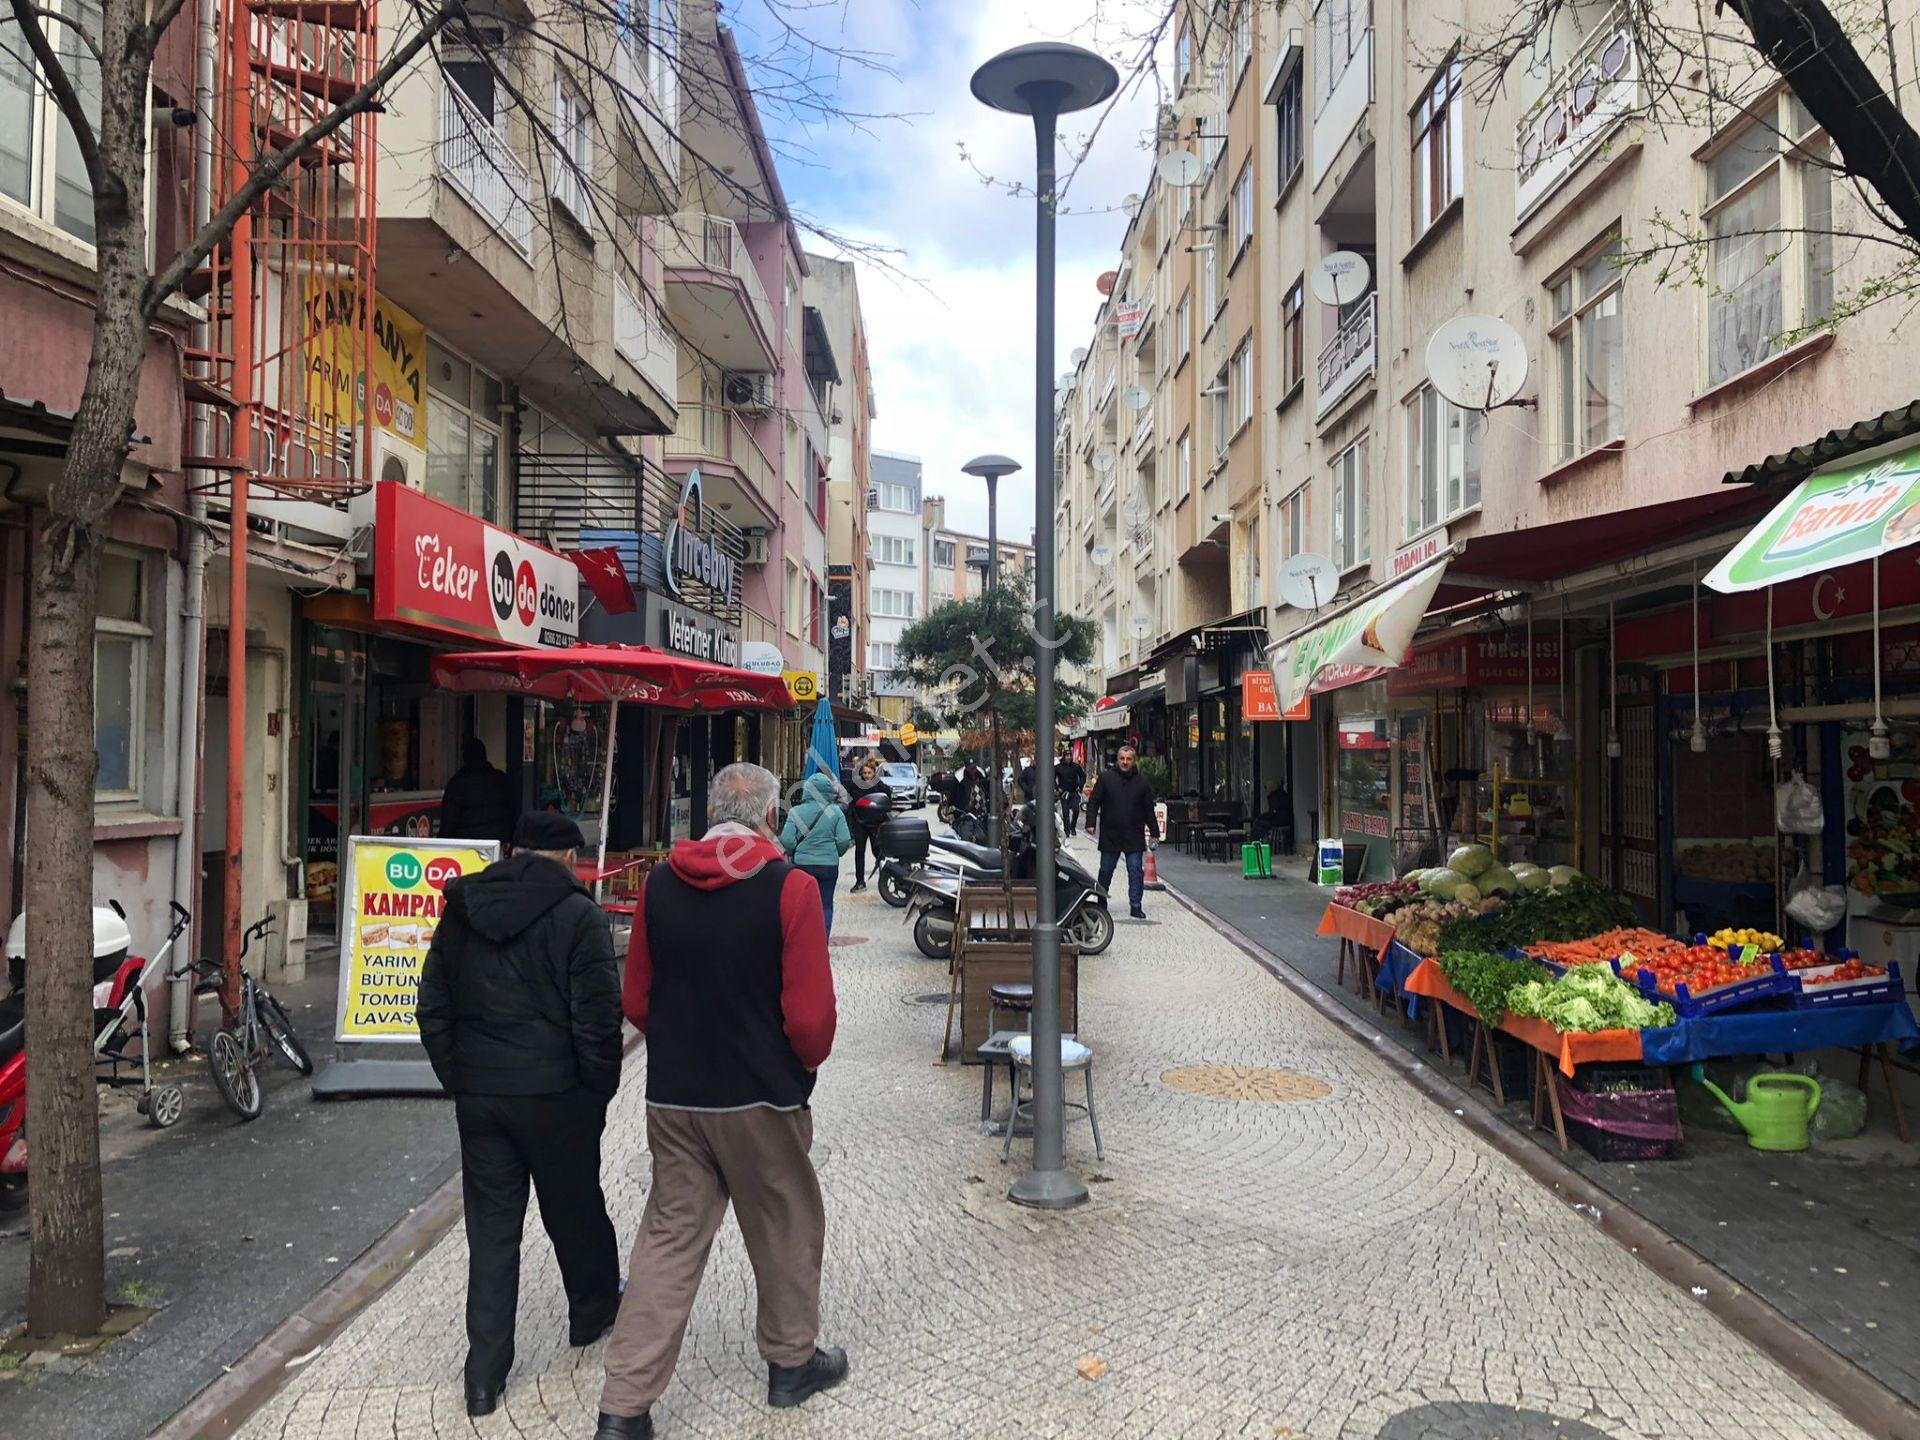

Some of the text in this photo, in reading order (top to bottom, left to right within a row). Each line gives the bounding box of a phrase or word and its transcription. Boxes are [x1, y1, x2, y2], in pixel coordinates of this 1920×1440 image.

[1777, 485, 1902, 545] Banvit
[540, 583, 576, 624] döner
[389, 863, 418, 879] BU
[362, 954, 417, 968] YARIM
[361, 971, 420, 987] BÜTÜN
[354, 1011, 415, 1026] LAVAŞ
